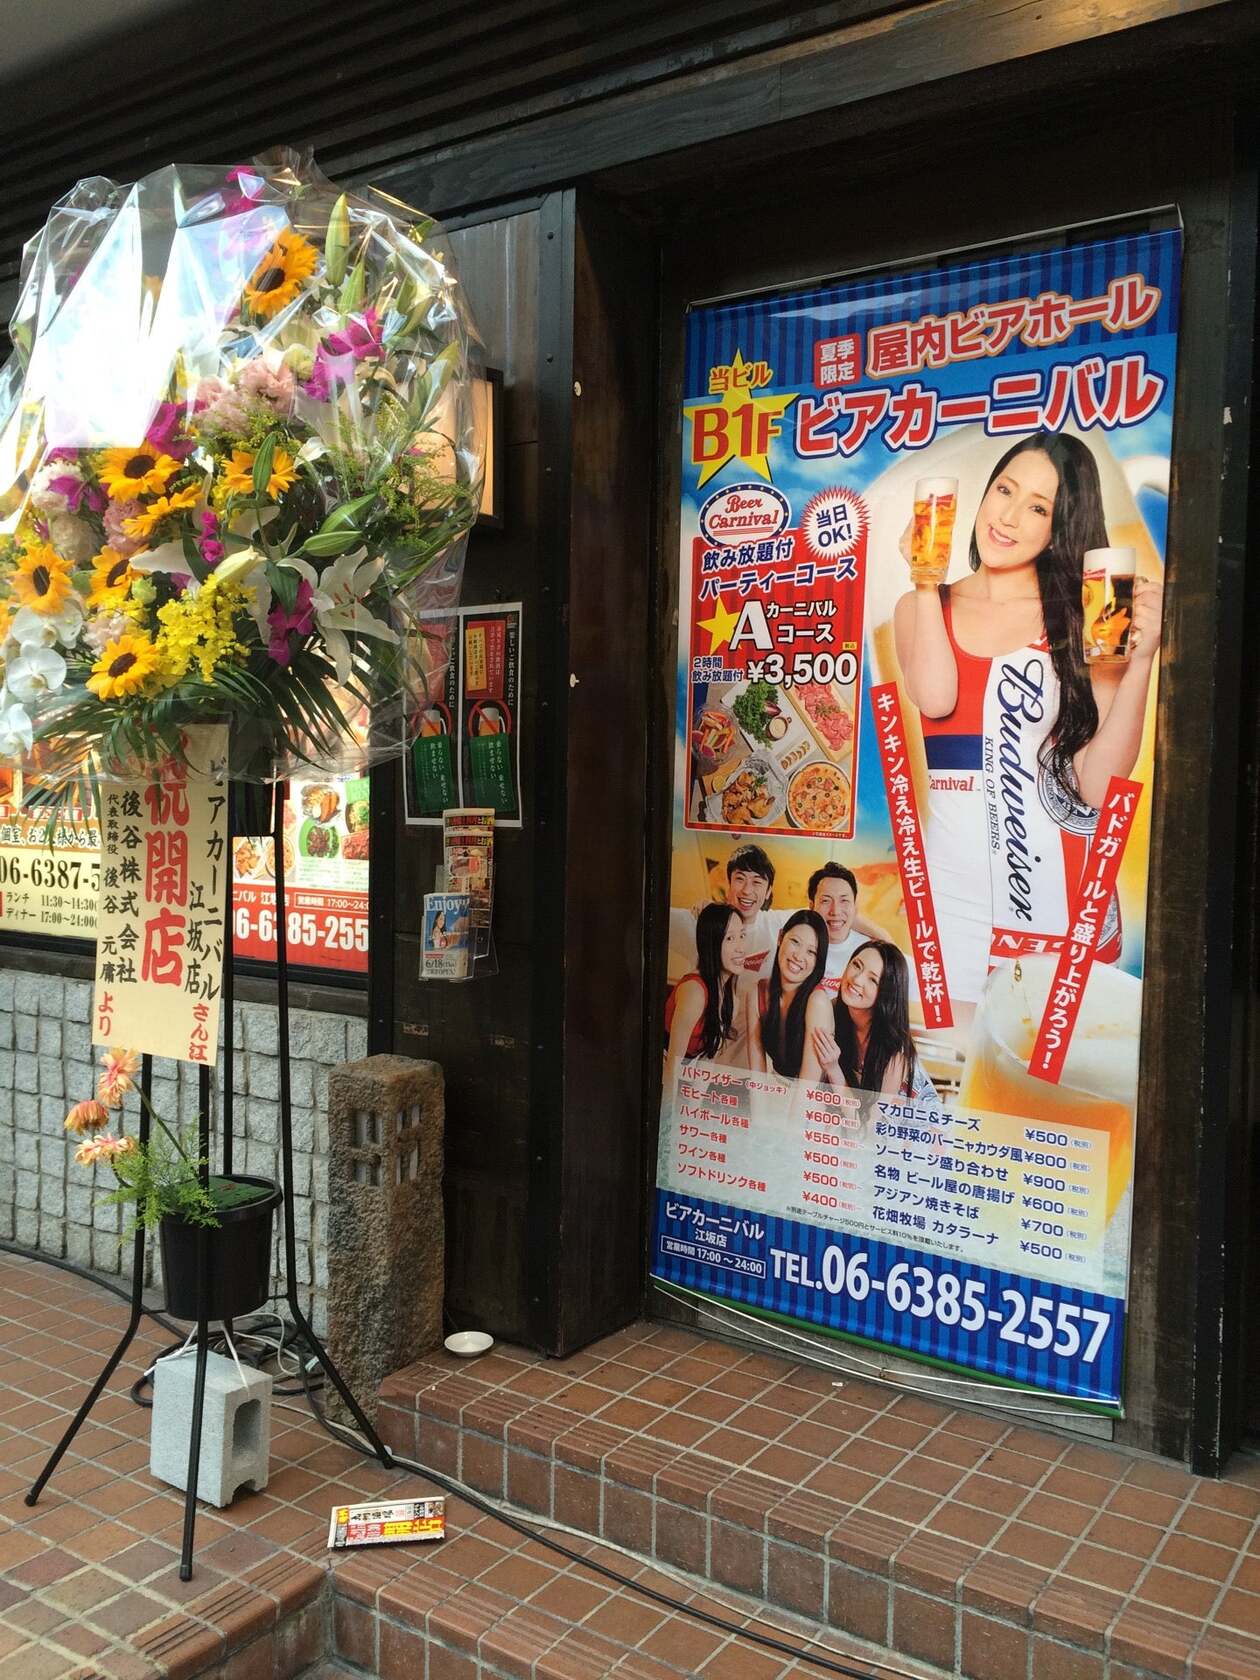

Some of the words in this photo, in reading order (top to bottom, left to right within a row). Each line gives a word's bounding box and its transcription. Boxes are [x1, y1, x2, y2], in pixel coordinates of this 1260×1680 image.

[869, 275, 1159, 376] 屋内ビアホール
[820, 338, 856, 363] 夏季
[710, 362, 773, 393] 当ビル
[820, 362, 856, 386] 限定
[797, 358, 1161, 457] ビアカーニバル
[692, 402, 783, 463] B1F
[708, 509, 780, 530] Carnival
[725, 494, 764, 514] Beer
[816, 503, 849, 528] 当日
[703, 537, 794, 571] 飲み放題付
[818, 523, 854, 547] OK!
[700, 557, 858, 599] パーティーコース
[729, 600, 775, 651] A
[766, 601, 837, 618] カーニバル
[777, 623, 834, 643] コース
[692, 669, 744, 682] 飲み放題付
[693, 657, 723, 669] 2時間
[748, 652, 857, 687] ¥3,500
[985, 737, 994, 773] KING
[929, 776, 975, 791] arnival
[986, 778, 996, 798] OF
[997, 659, 1044, 921] Budweiser
[989, 802, 1001, 850] BEERS
[877, 692, 945, 1024] キンキン冷え冷え生ビールで乾杯!
[103, 867, 120, 915] 後谷
[115, 790, 144, 984] 後谷株式会社
[184, 880, 206, 995] 江坂店
[1041, 790, 1137, 1072] バドガールと盛り上がろう!
[98, 991, 114, 1037] より
[681, 1085, 738, 1106] モヒート各種
[806, 1110, 840, 1126] ¥600
[682, 1066, 742, 1086] バドワイザー
[806, 1088, 841, 1105] ¥600
[680, 1105, 749, 1129] ハイボール各種
[805, 1130, 839, 1146] ¥550
[877, 1102, 981, 1131] マカロニ&チーズ
[1025, 1129, 1068, 1146] ¥500
[678, 1143, 726, 1163] ワイン各種
[803, 1170, 838, 1187] ¥500
[679, 1124, 727, 1144] サワー各種
[804, 1151, 839, 1167] ¥500
[875, 1122, 1023, 1162] 彩り野菜のバーニャカウダ風
[1024, 1151, 1067, 1169] ¥800
[678, 1162, 767, 1192] ソフトドリンク各種
[802, 1191, 837, 1208] ¥400
[875, 1144, 1009, 1181] ソーセージ盛り合わせ
[1023, 1173, 1066, 1191] ¥900
[874, 1164, 900, 1181] 名物
[906, 1171, 1016, 1205] ビール屋の唐揚げ
[1022, 1195, 1064, 1214] ¥600
[666, 1201, 764, 1240] ビアカーニバル
[873, 1185, 980, 1219] アジアン焼きそば
[1021, 1217, 1064, 1237] ¥700
[666, 1241, 696, 1256] 営業時間
[695, 1228, 727, 1248] 江坂店
[872, 1205, 927, 1230] 花畑牧場
[932, 1220, 999, 1245] カタラーナ
[1020, 1240, 1062, 1259] ¥500
